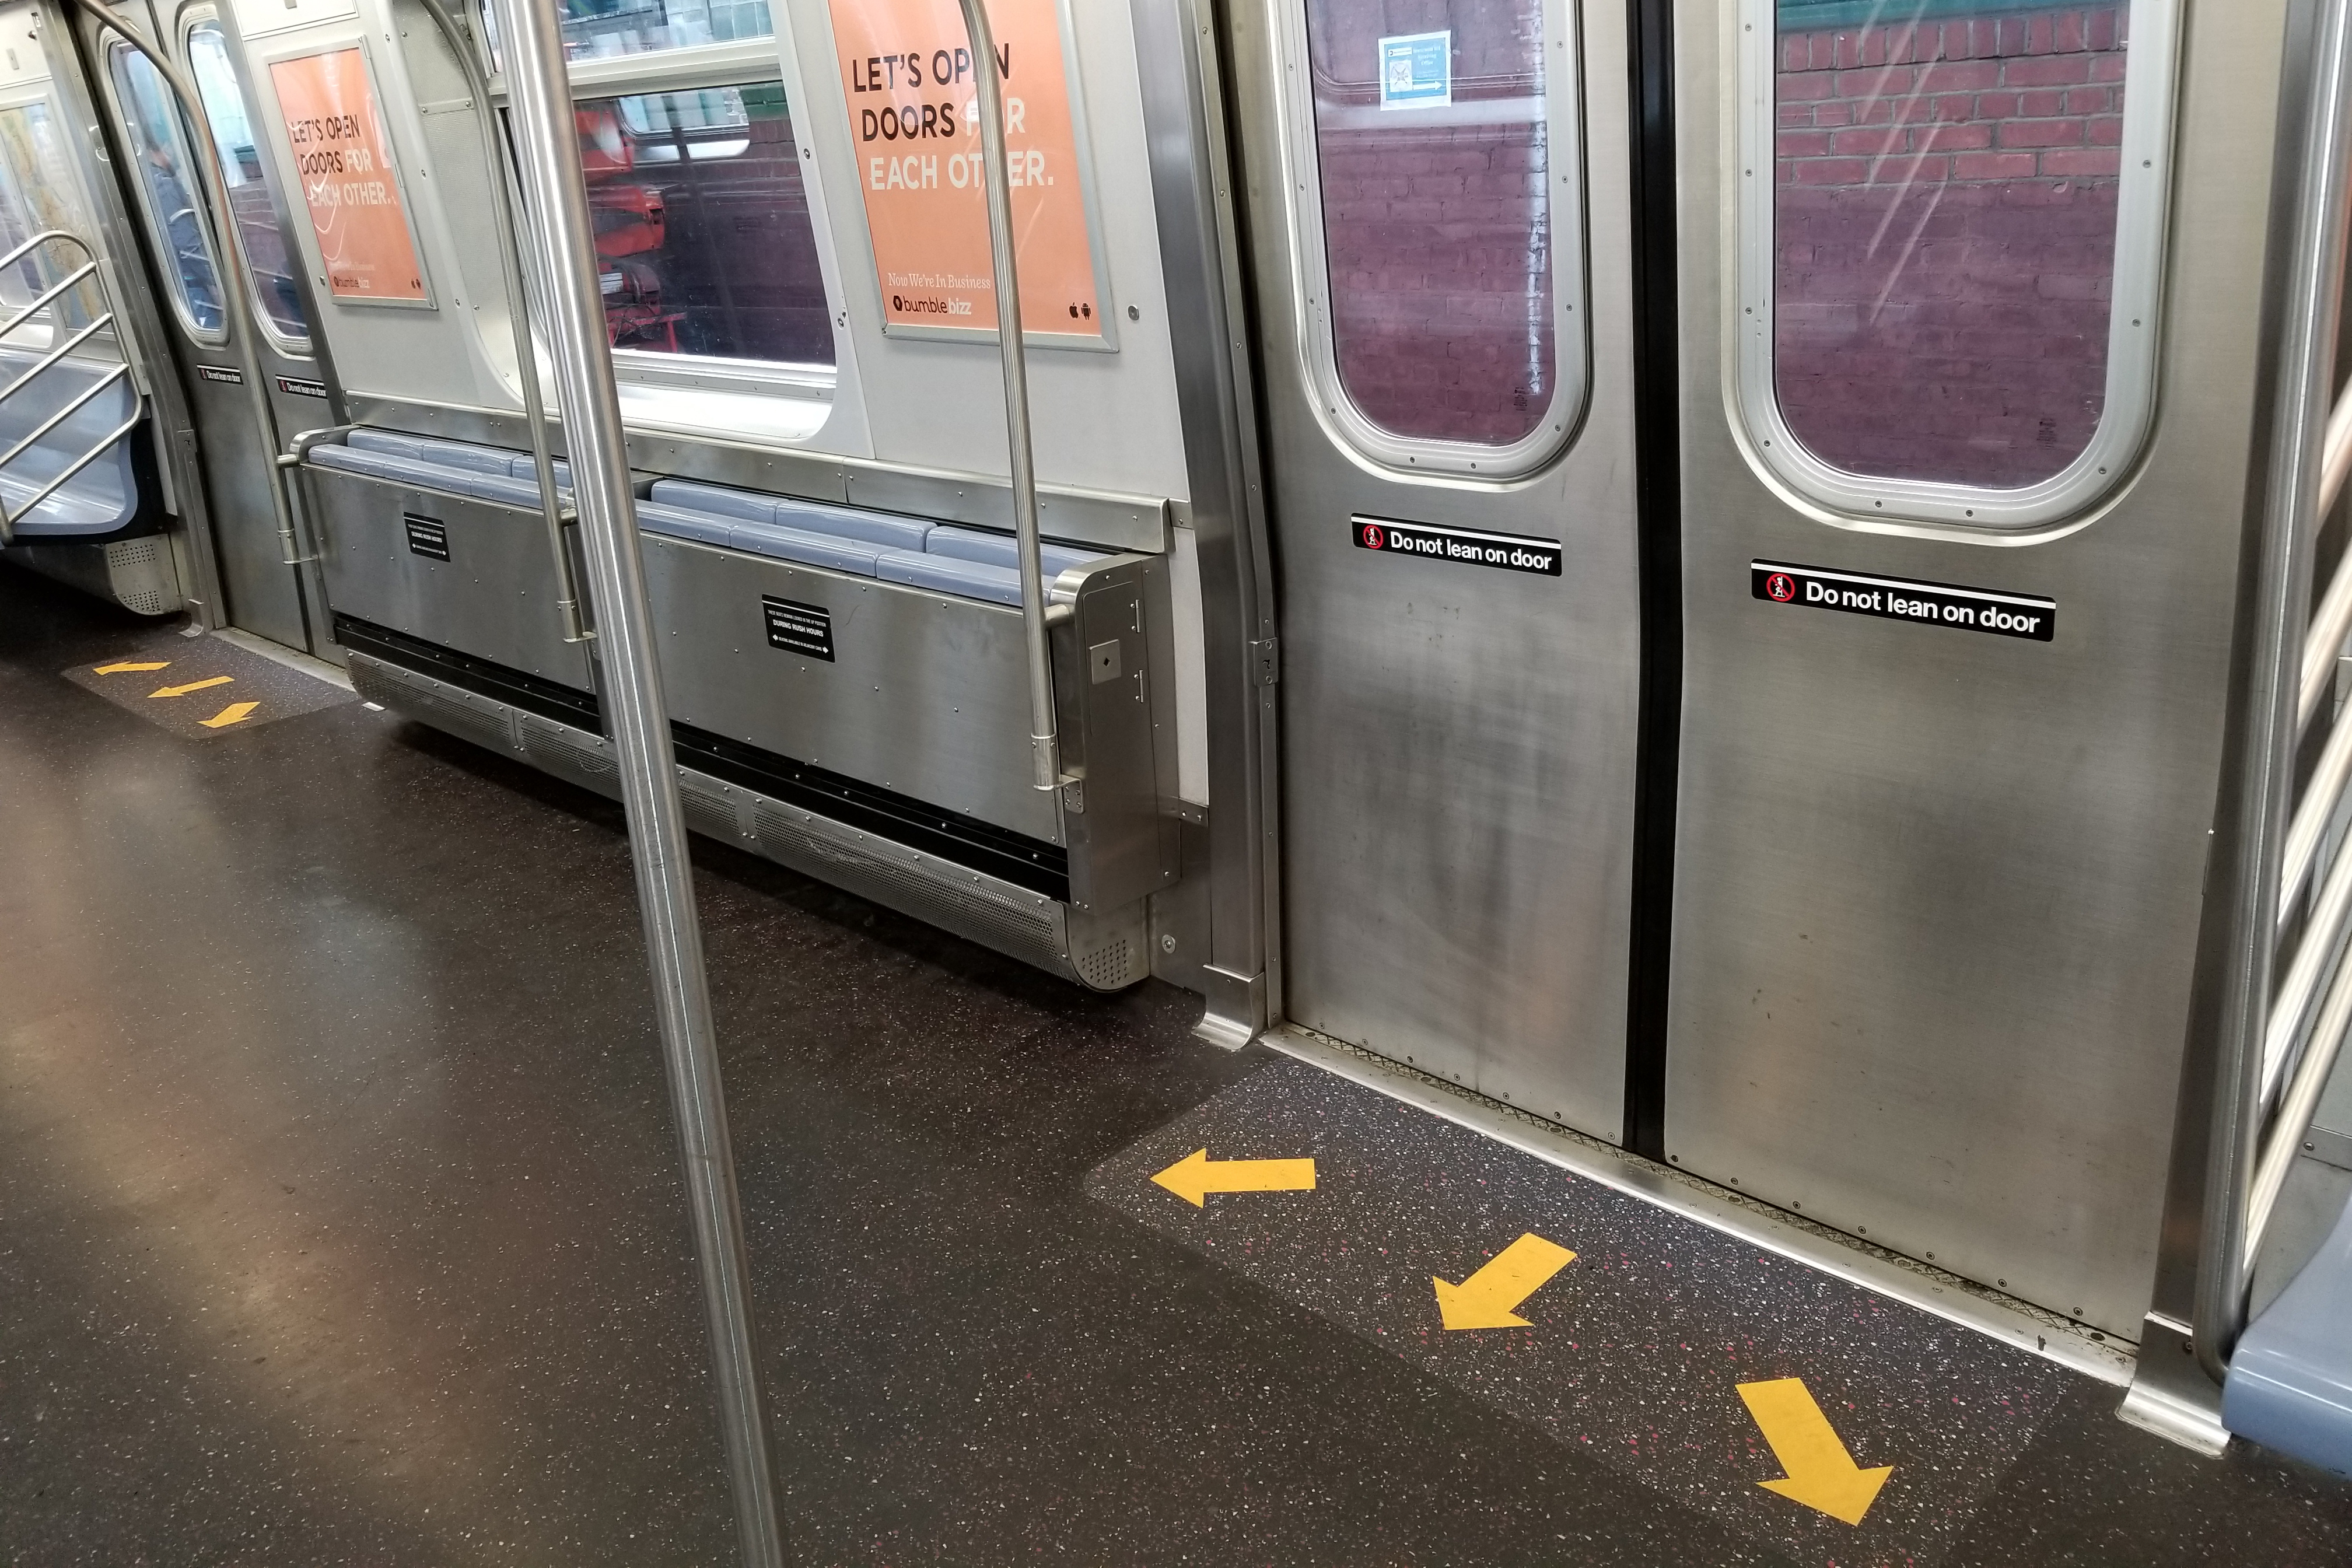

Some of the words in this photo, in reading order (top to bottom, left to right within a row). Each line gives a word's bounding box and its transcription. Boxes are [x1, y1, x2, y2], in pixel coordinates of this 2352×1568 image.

[852, 52, 922, 93] LET'S
[932, 43, 1009, 85] OPN
[291, 118, 323, 144] LET'S
[326, 114, 360, 140] OPEN
[862, 103, 956, 142] DOORS
[967, 97, 1026, 136] FR
[300, 150, 343, 175] DOORS
[345, 149, 373, 172] FOR
[870, 155, 937, 190] EACH
[948, 150, 1054, 188] OTER.
[309, 184, 341, 206] EACH
[344, 182, 390, 205] OTHER.
[888, 273, 908, 286] Now
[908, 274, 934, 287] We're
[936, 274, 946, 288] In
[948, 275, 991, 289] Business
[286, 382, 294, 391] Do
[293, 384, 301, 393] not
[300, 384, 311, 394] lean
[1390, 531, 1413, 550] Do
[1416, 538, 1443, 555] not
[1447, 539, 1482, 560] lean
[1485, 548, 1507, 564] on
[1510, 549, 1552, 570] door
[1806, 581, 1839, 604] Do
[1842, 591, 1881, 611] not
[1888, 592, 1938, 618] lean
[1943, 605, 1975, 624] on
[1980, 607, 2041, 633] door
[772, 619, 792, 629] DURING
[792, 624, 806, 633] RUSH
[806, 627, 824, 637] HOURS
